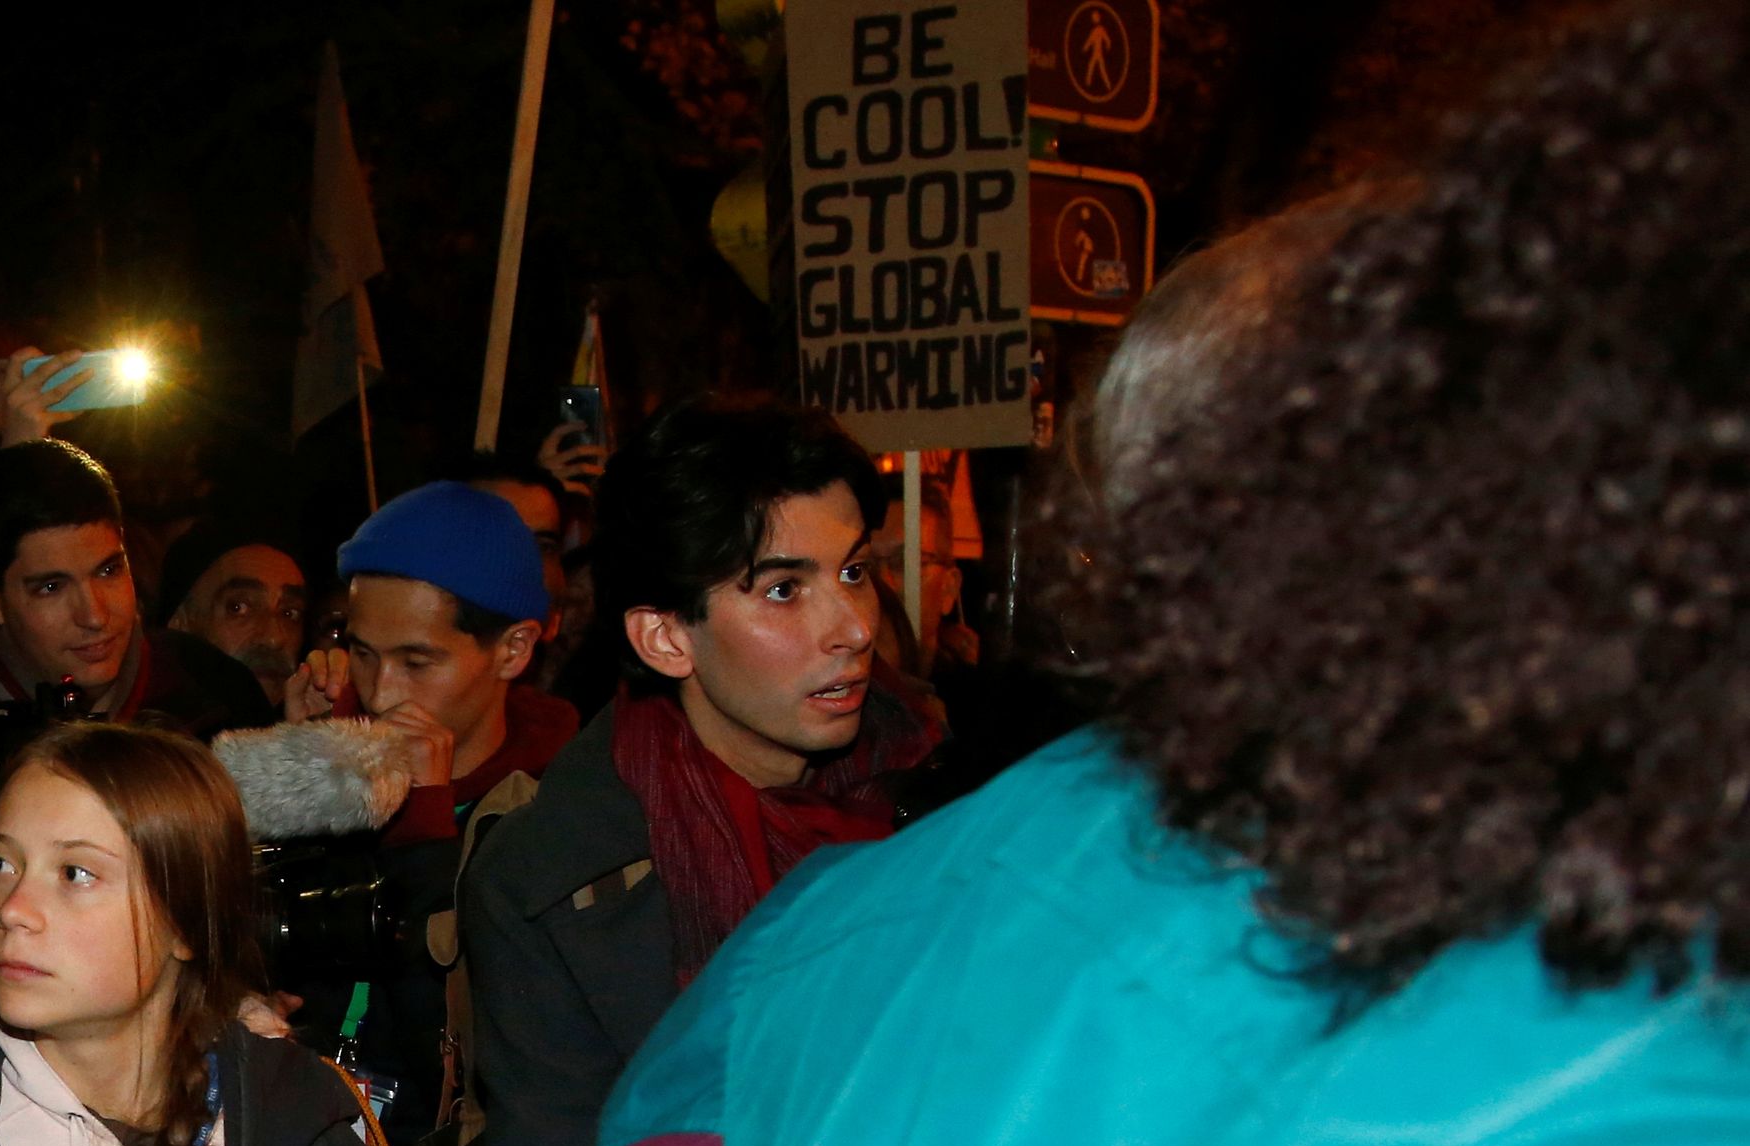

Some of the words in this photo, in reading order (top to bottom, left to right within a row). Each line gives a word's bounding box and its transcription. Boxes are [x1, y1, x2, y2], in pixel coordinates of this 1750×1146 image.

[853, 7, 957, 86] BE
[803, 76, 1027, 170] COOL!
[803, 170, 1016, 258] STOP
[799, 252, 1021, 339] GLOBAL
[801, 330, 1028, 414] WARMING
